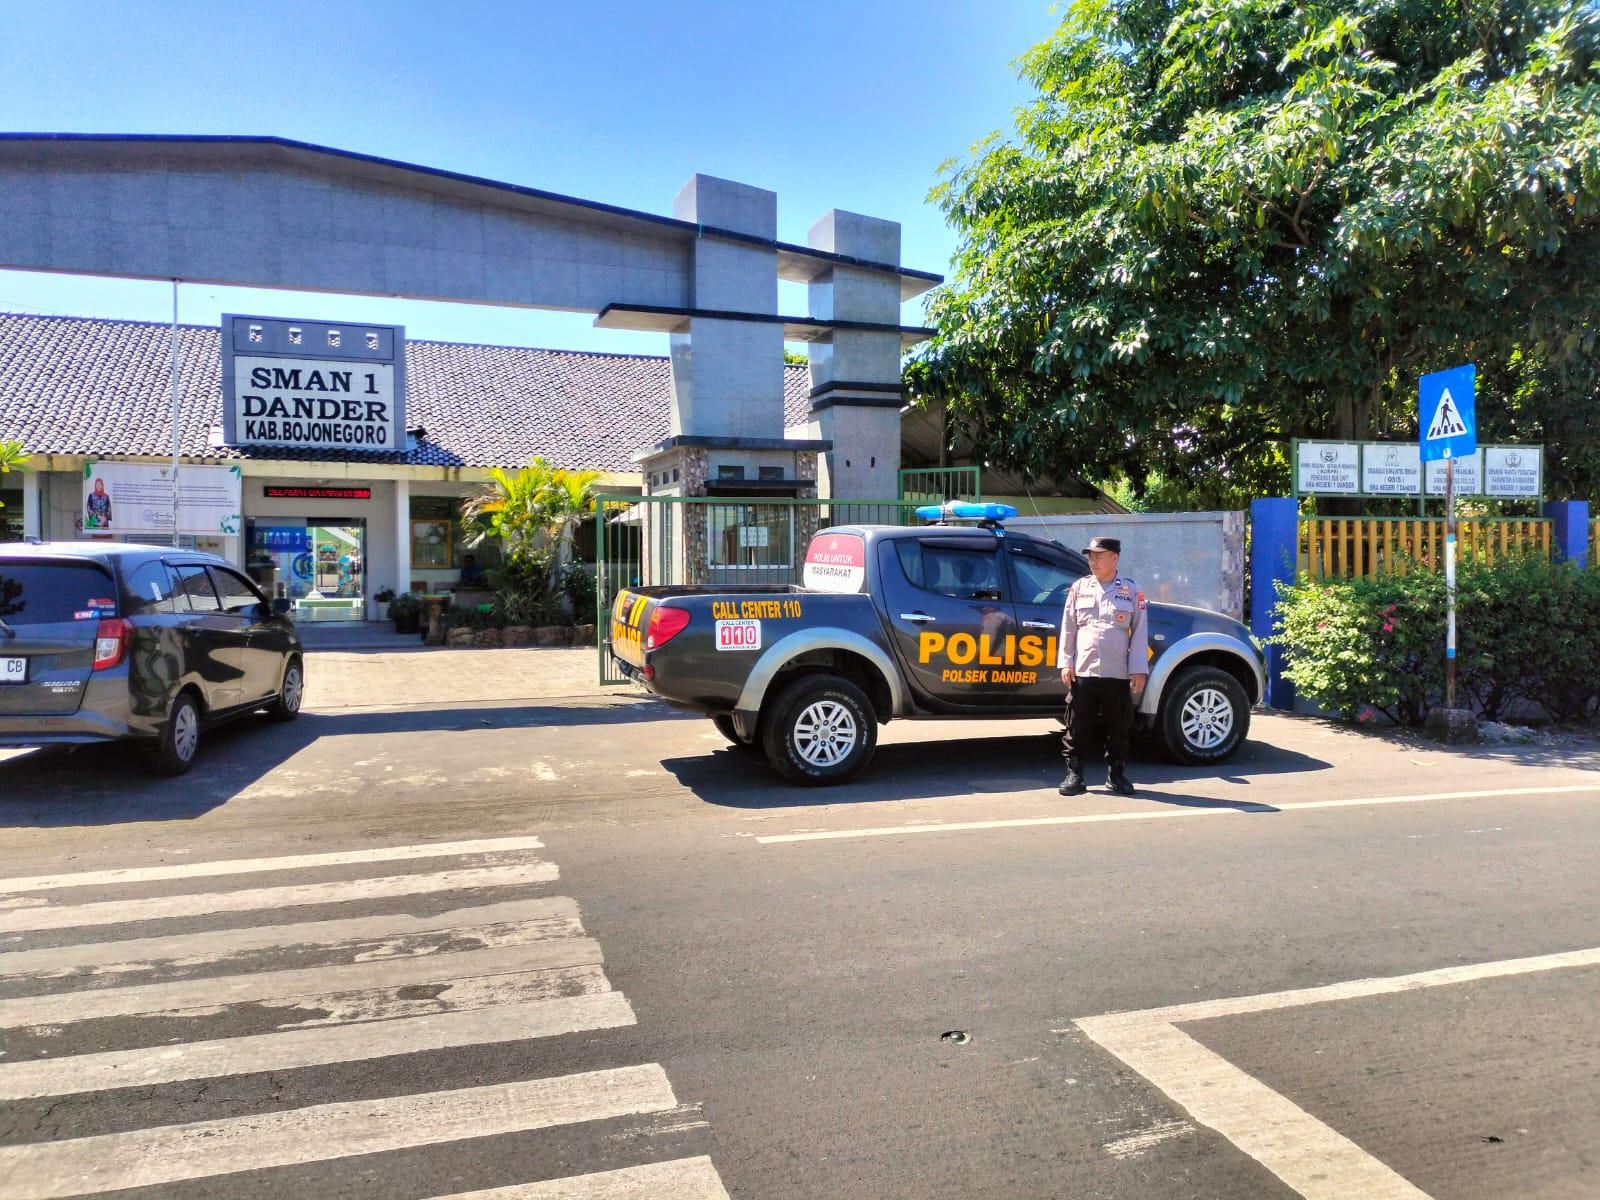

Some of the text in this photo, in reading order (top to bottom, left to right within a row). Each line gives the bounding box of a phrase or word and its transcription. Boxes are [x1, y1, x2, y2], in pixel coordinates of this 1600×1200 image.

[251, 367, 379, 394] SMAN 1
[242, 395, 389, 422] DANDER
[246, 420, 386, 444] KAB.BOJONEGORO
[813, 552, 854, 564] POLRI UNTUK
[812, 566, 852, 578] MASYARAKAT
[712, 600, 801, 619] CALL CENTER 110
[721, 626, 756, 645] 110
[919, 632, 1057, 666] POLISI
[7, 660, 22, 673] CB
[942, 669, 1037, 684] POLSEK DANDER
